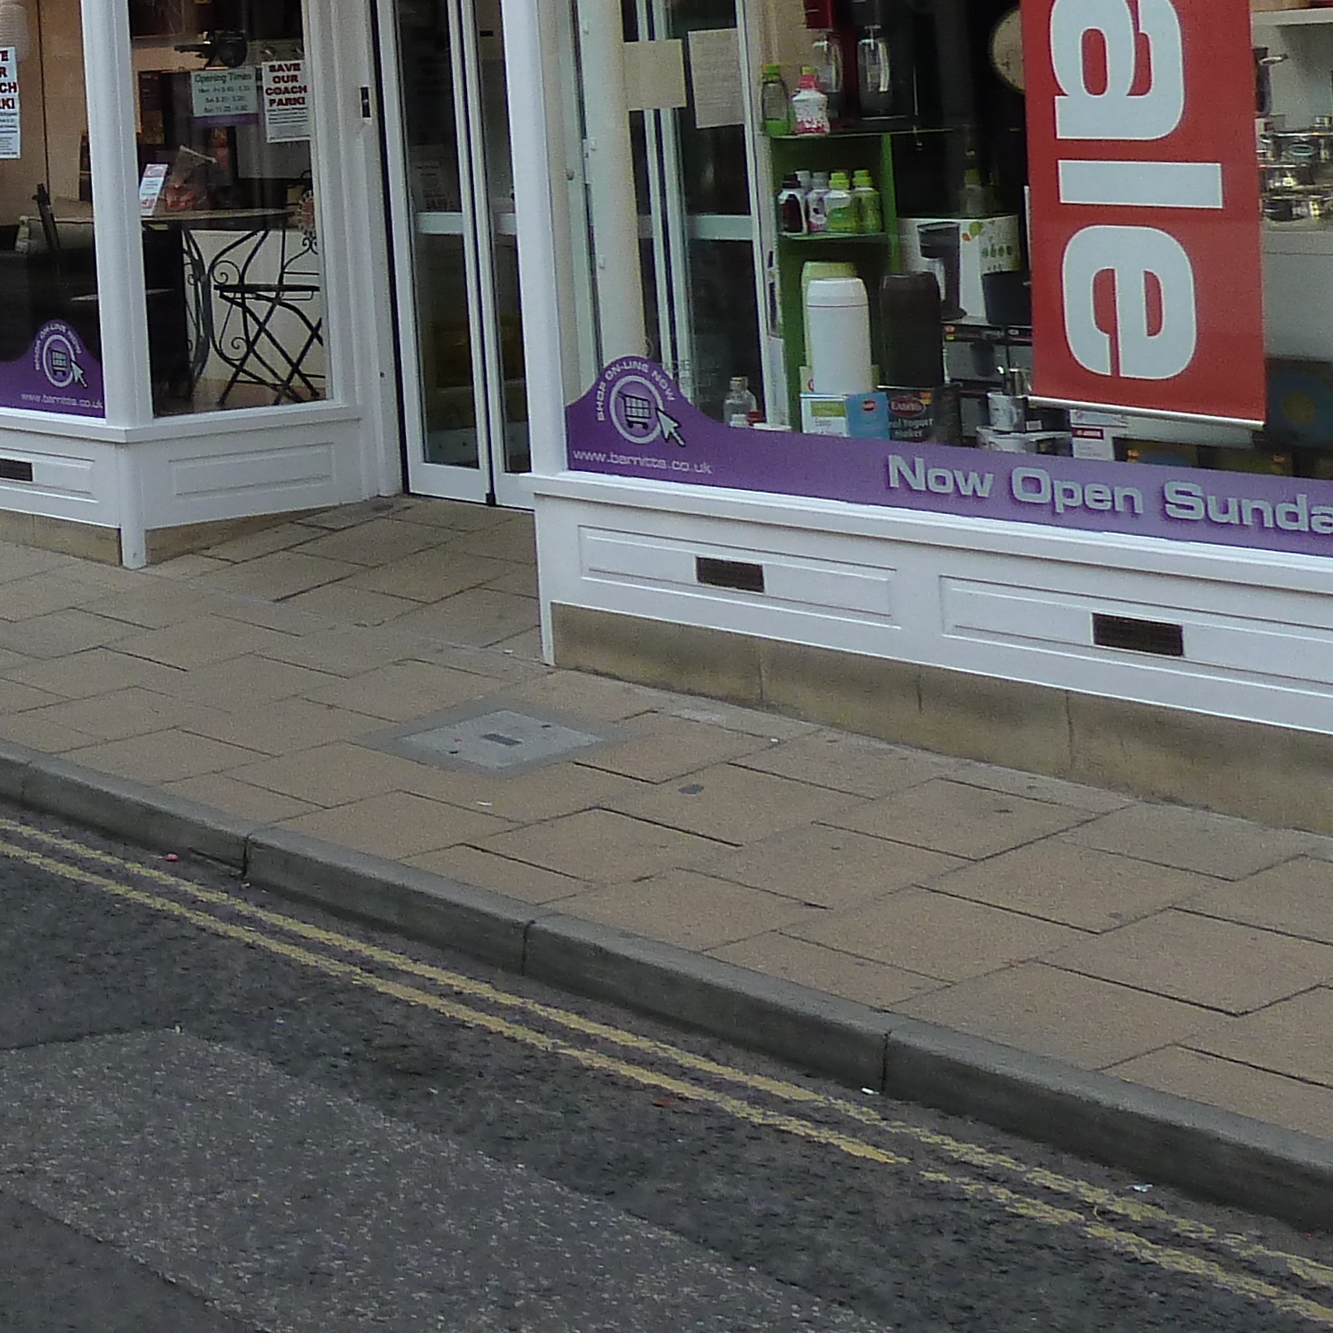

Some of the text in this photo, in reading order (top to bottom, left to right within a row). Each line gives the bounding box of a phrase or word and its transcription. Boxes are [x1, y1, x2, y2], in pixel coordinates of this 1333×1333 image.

[269, 63, 301, 73] SAVE
[272, 74, 299, 84] OUR
[265, 85, 307, 96] COACH
[596, 381, 605, 421] SHOP
[651, 370, 675, 401] NOW
[887, 454, 994, 497] Now
[1012, 466, 1142, 514] Open
